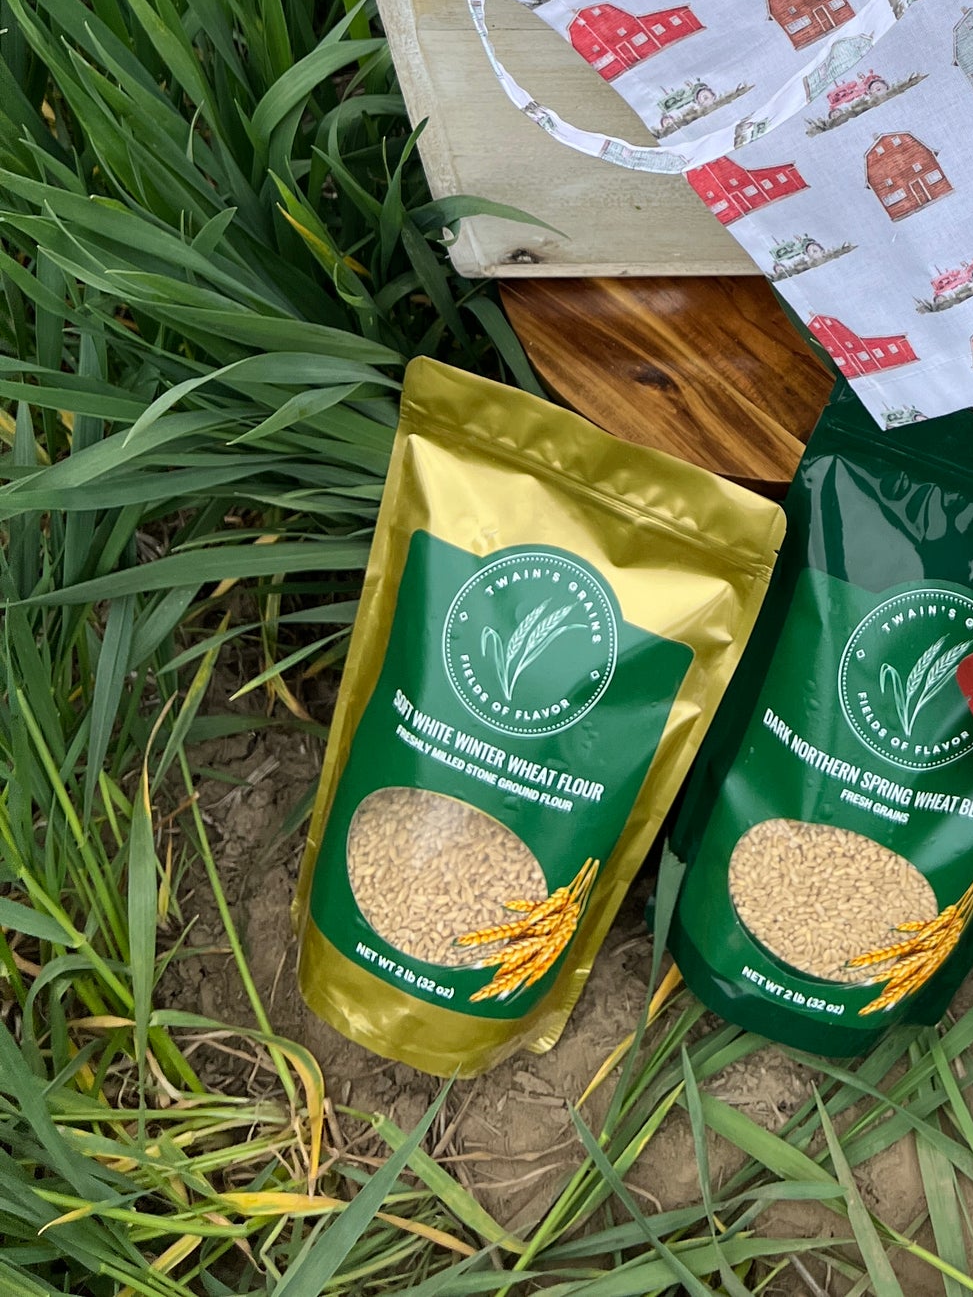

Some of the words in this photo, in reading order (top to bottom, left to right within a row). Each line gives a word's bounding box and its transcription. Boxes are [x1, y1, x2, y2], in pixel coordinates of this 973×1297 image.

[484, 568, 561, 597] TWAIN'S
[568, 581, 602, 644] GRAINS
[881, 605, 957, 634] TWAIN'S
[460, 654, 489, 702] FIELDS
[491, 701, 510, 716] OF
[515, 698, 570, 720] FLAVOR
[393, 689, 414, 721] SOFT
[413, 709, 455, 745] WHITE
[454, 730, 506, 768] WINTER
[507, 754, 557, 785] WHEAT
[557, 775, 605, 801] FLOUR
[858, 691, 888, 738] FIELDS
[890, 737, 909, 751] OF
[914, 730, 969, 756] FLAVOR
[396, 724, 432, 754] FRESHLY
[430, 746, 466, 771] MILLED
[465, 763, 498, 785] STONE
[497, 777, 540, 801] GROUND
[539, 793, 574, 812] FLOUR
[762, 707, 793, 746] DARK
[790, 734, 861, 784] NORTHERN
[860, 771, 914, 807] SPRING
[913, 790, 960, 812] WHEAT
[840, 788, 873, 810] FRESH
[872, 802, 910, 824] GRAINS
[356, 941, 378, 962] NET
[378, 955, 397, 973] WT
[394, 965, 405, 978] 2
[403, 969, 416, 983] lb
[416, 975, 436, 993] (32
[435, 985, 455, 1000] oz)
[741, 966, 766, 986] NET
[765, 979, 785, 996] WT
[783, 990, 793, 1000] 2
[792, 992, 806, 1005] lb
[806, 996, 827, 1011] (32
[825, 1003, 845, 1015] oz)
